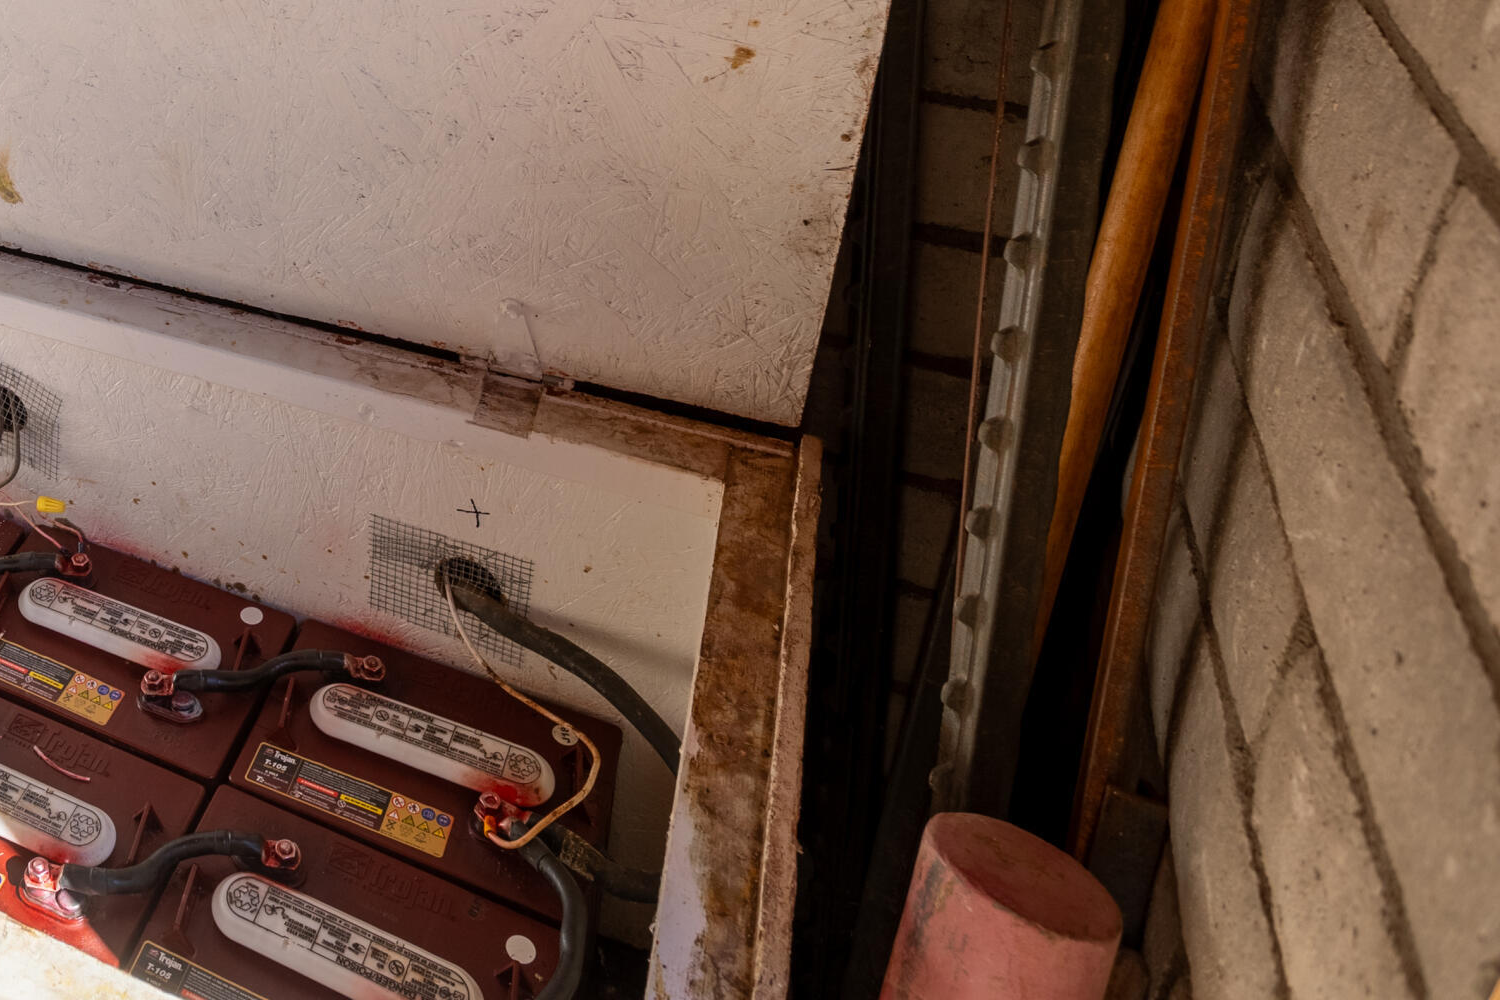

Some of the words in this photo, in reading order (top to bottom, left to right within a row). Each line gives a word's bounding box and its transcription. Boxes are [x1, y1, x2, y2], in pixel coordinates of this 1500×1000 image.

[265, 759, 288, 771] T-105
[274, 750, 297, 765] Trojan
[158, 951, 183, 971] Trojan
[146, 962, 172, 980] T-105
